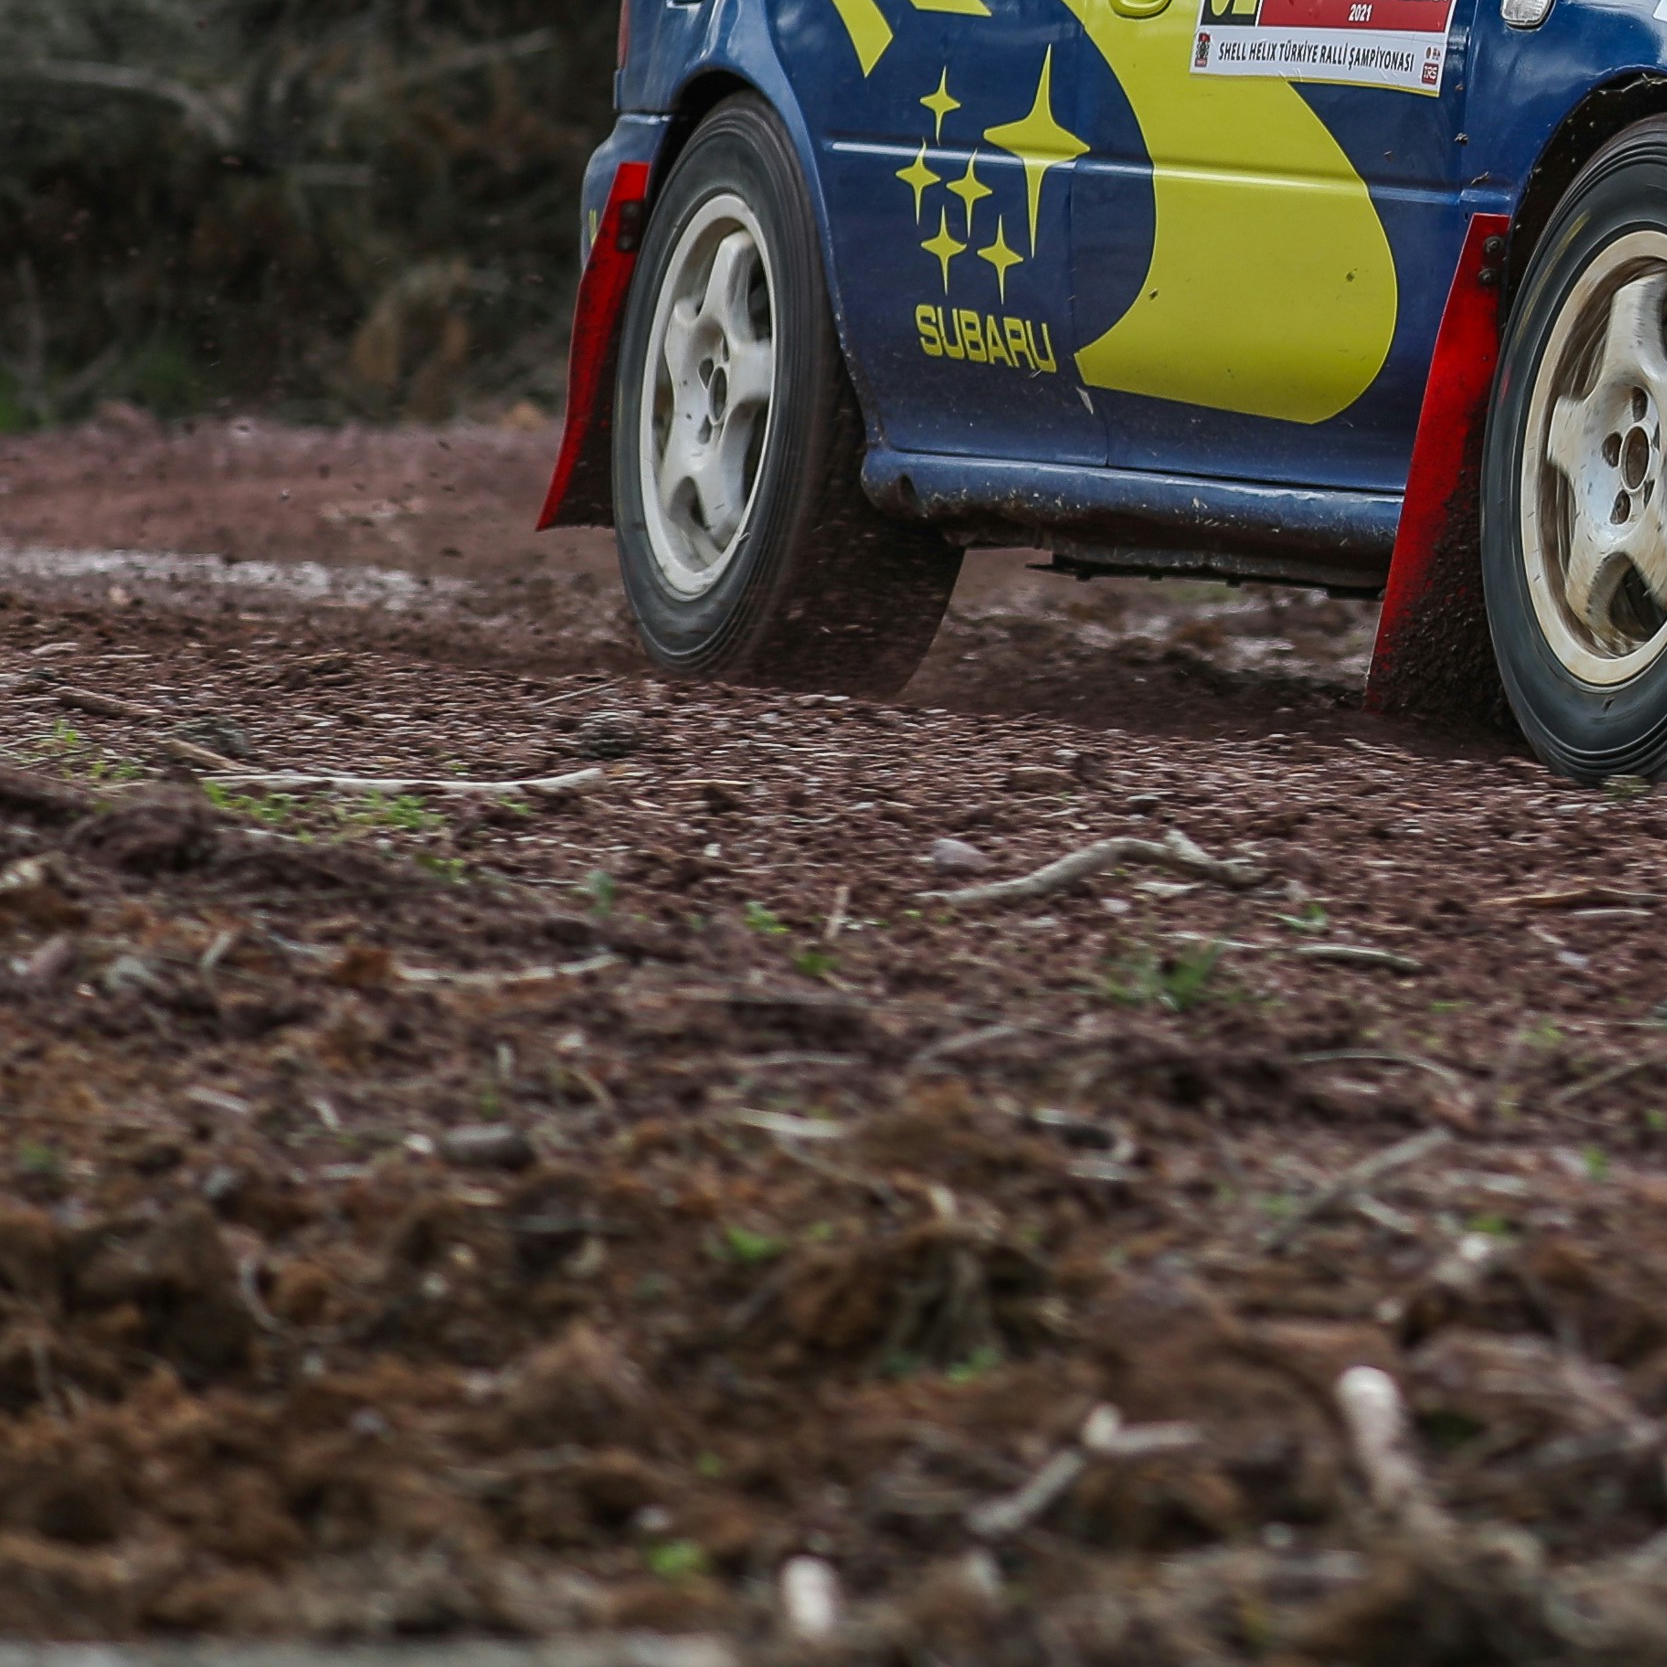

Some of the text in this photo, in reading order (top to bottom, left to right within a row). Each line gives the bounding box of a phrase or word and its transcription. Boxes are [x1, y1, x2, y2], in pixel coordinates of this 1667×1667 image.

[1348, 3, 1372, 22] 2021
[1218, 38, 1414, 72] SHELL HELIX TÜRKİYE RALLİ ŞAMPİYONASI
[915, 304, 1057, 373] SUBARU
